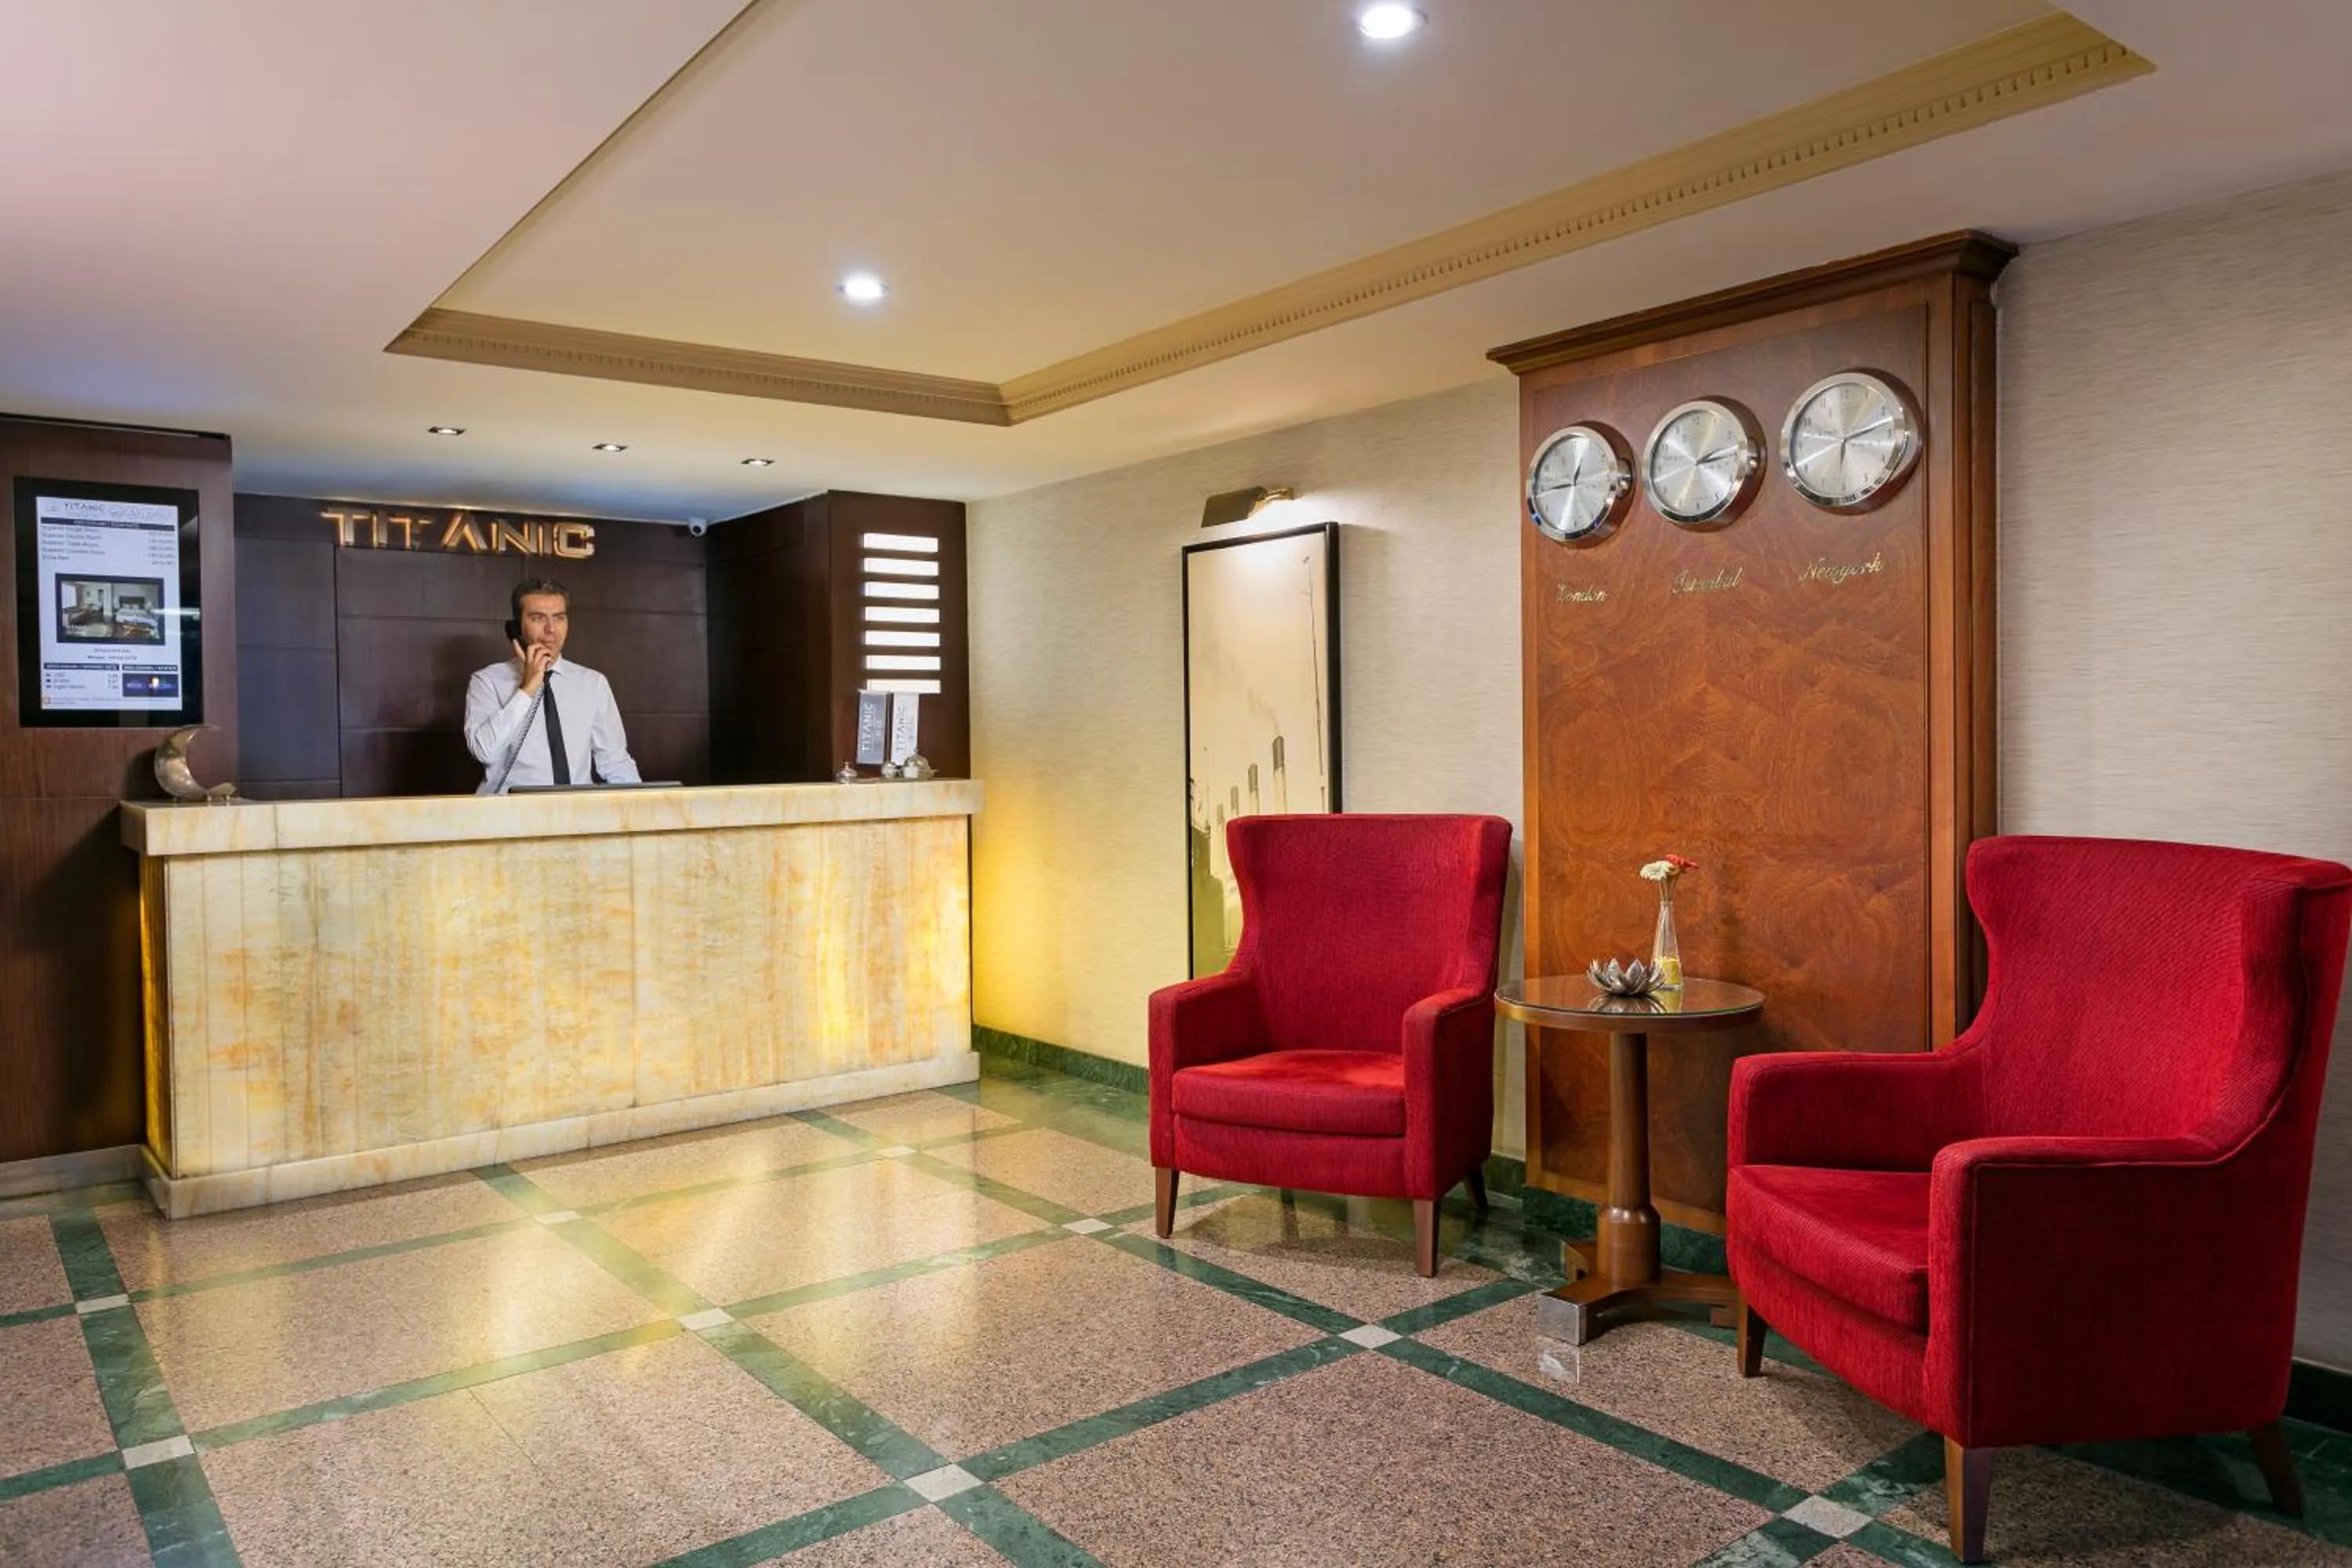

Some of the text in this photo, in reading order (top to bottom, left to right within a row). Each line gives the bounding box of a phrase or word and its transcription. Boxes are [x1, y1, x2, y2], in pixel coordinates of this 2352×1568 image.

[64, 503, 104, 512] TITANIC
[320, 506, 596, 559] TITANIC
[861, 702, 873, 753] TITANIC
[896, 706, 906, 753] TITANIC
